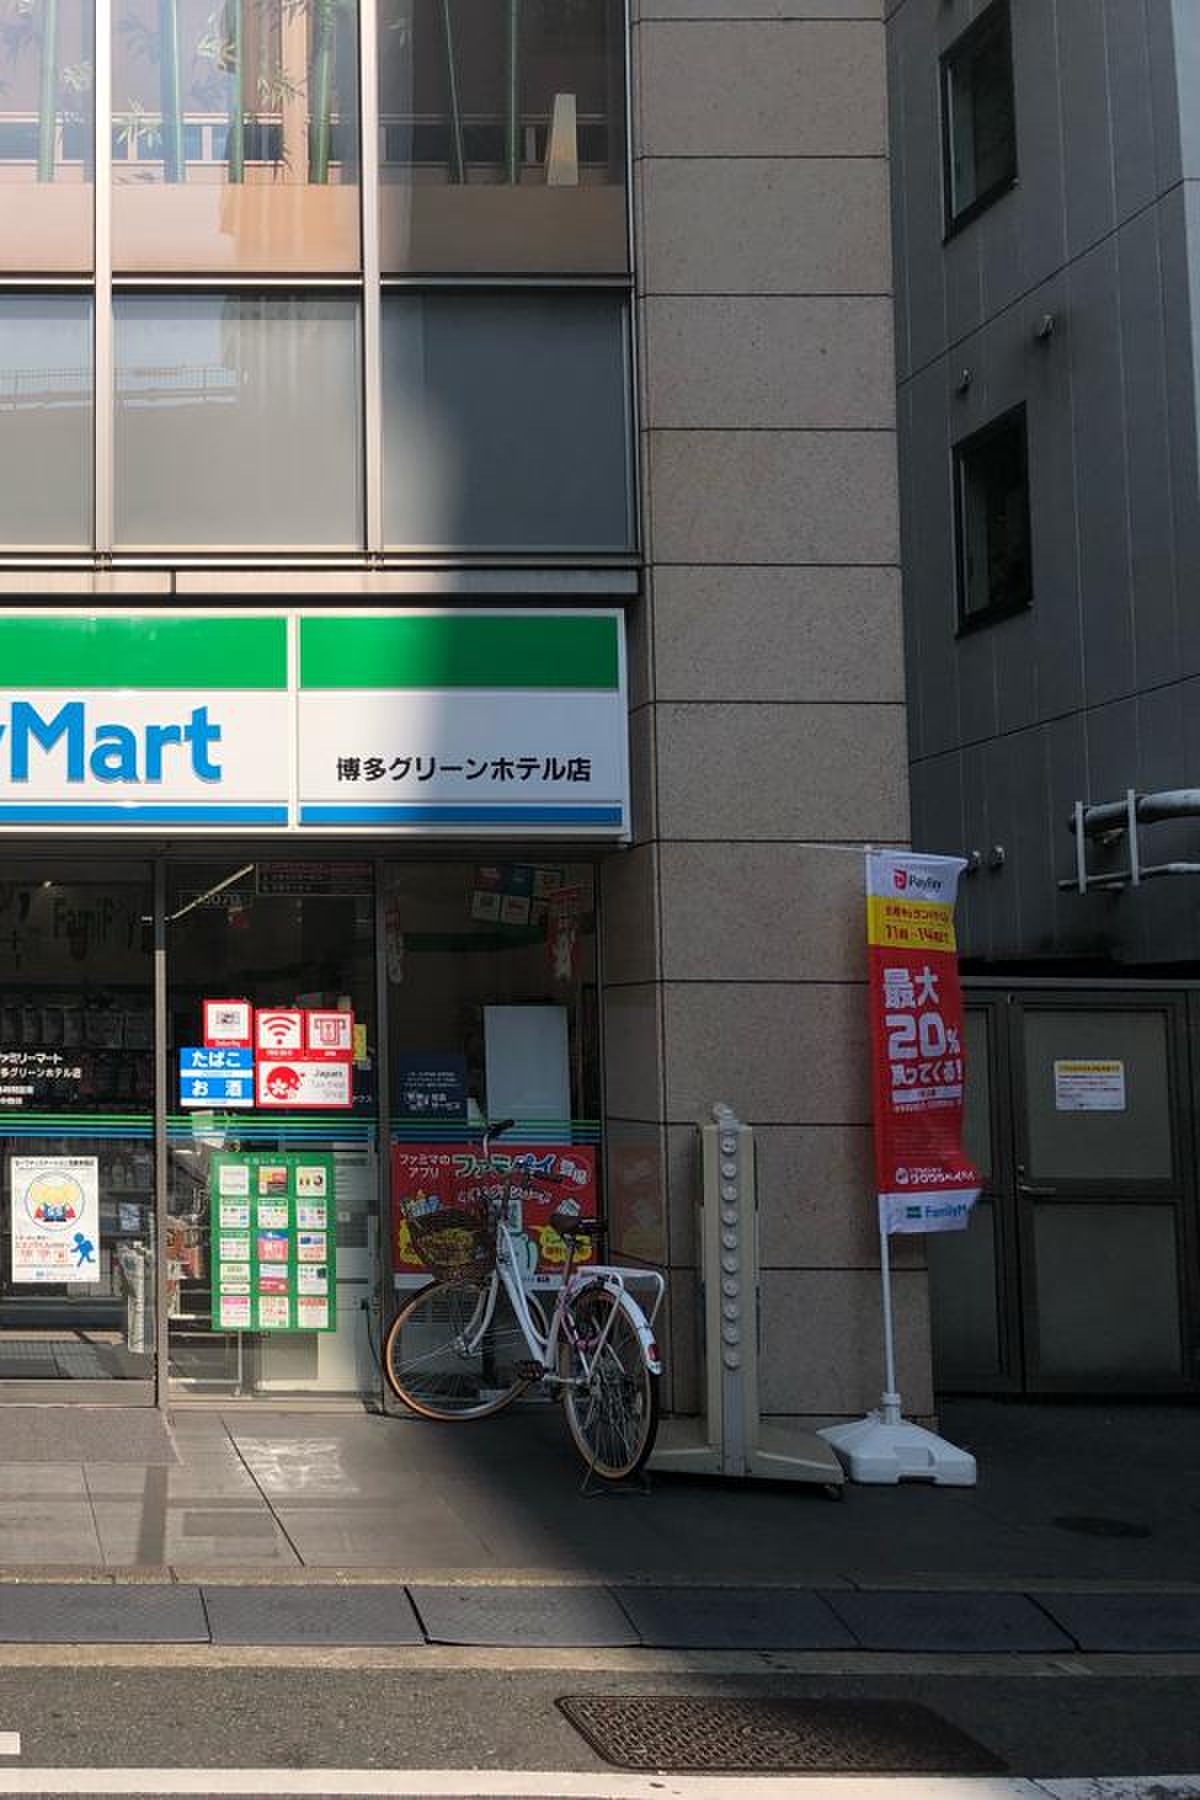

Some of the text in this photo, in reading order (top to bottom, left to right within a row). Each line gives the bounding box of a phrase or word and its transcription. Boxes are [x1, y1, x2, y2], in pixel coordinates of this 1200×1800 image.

[336, 757, 592, 782] 博多グリーンホテル店
[884, 965, 940, 1010] 最大
[886, 1012, 961, 1060] 20%
[191, 1051, 241, 1068] たばこ
